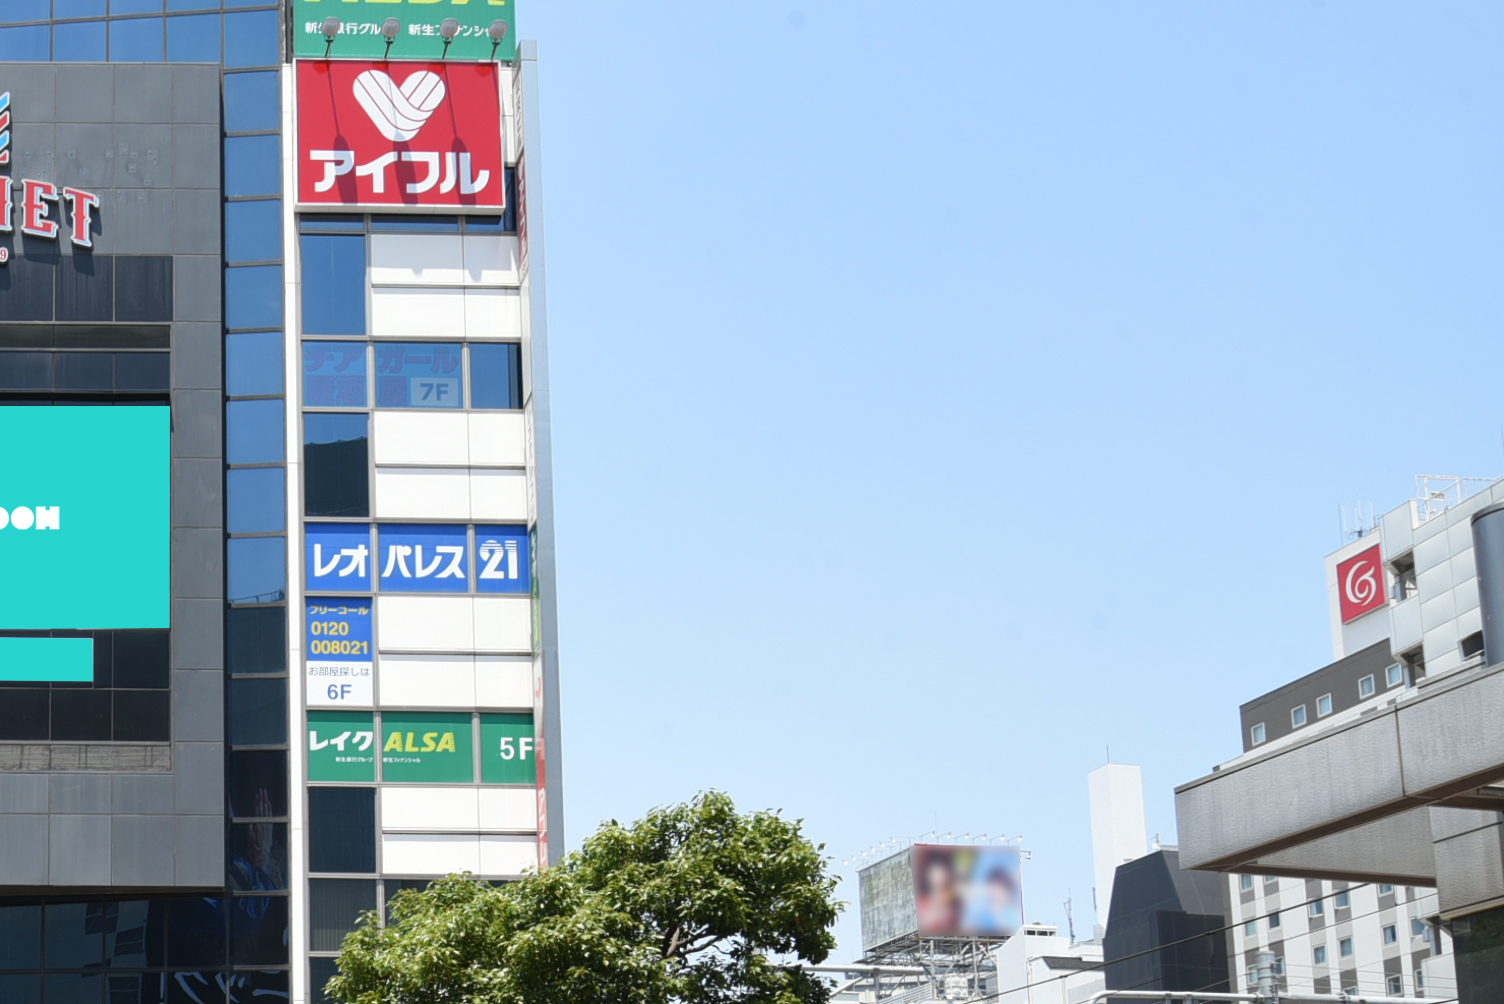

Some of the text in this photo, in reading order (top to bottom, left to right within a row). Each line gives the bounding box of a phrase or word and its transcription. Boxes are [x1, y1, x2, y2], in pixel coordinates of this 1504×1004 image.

[310, 150, 490, 195] アイフル
[419, 382, 449, 402] 7F
[309, 605, 369, 616] フリーコール
[311, 621, 350, 636] 0120
[311, 640, 369, 655] 008021
[308, 666, 370, 678] お部屋探しは
[327, 684, 353, 700] 6F
[309, 730, 534, 760] レイク ALSA 5F
